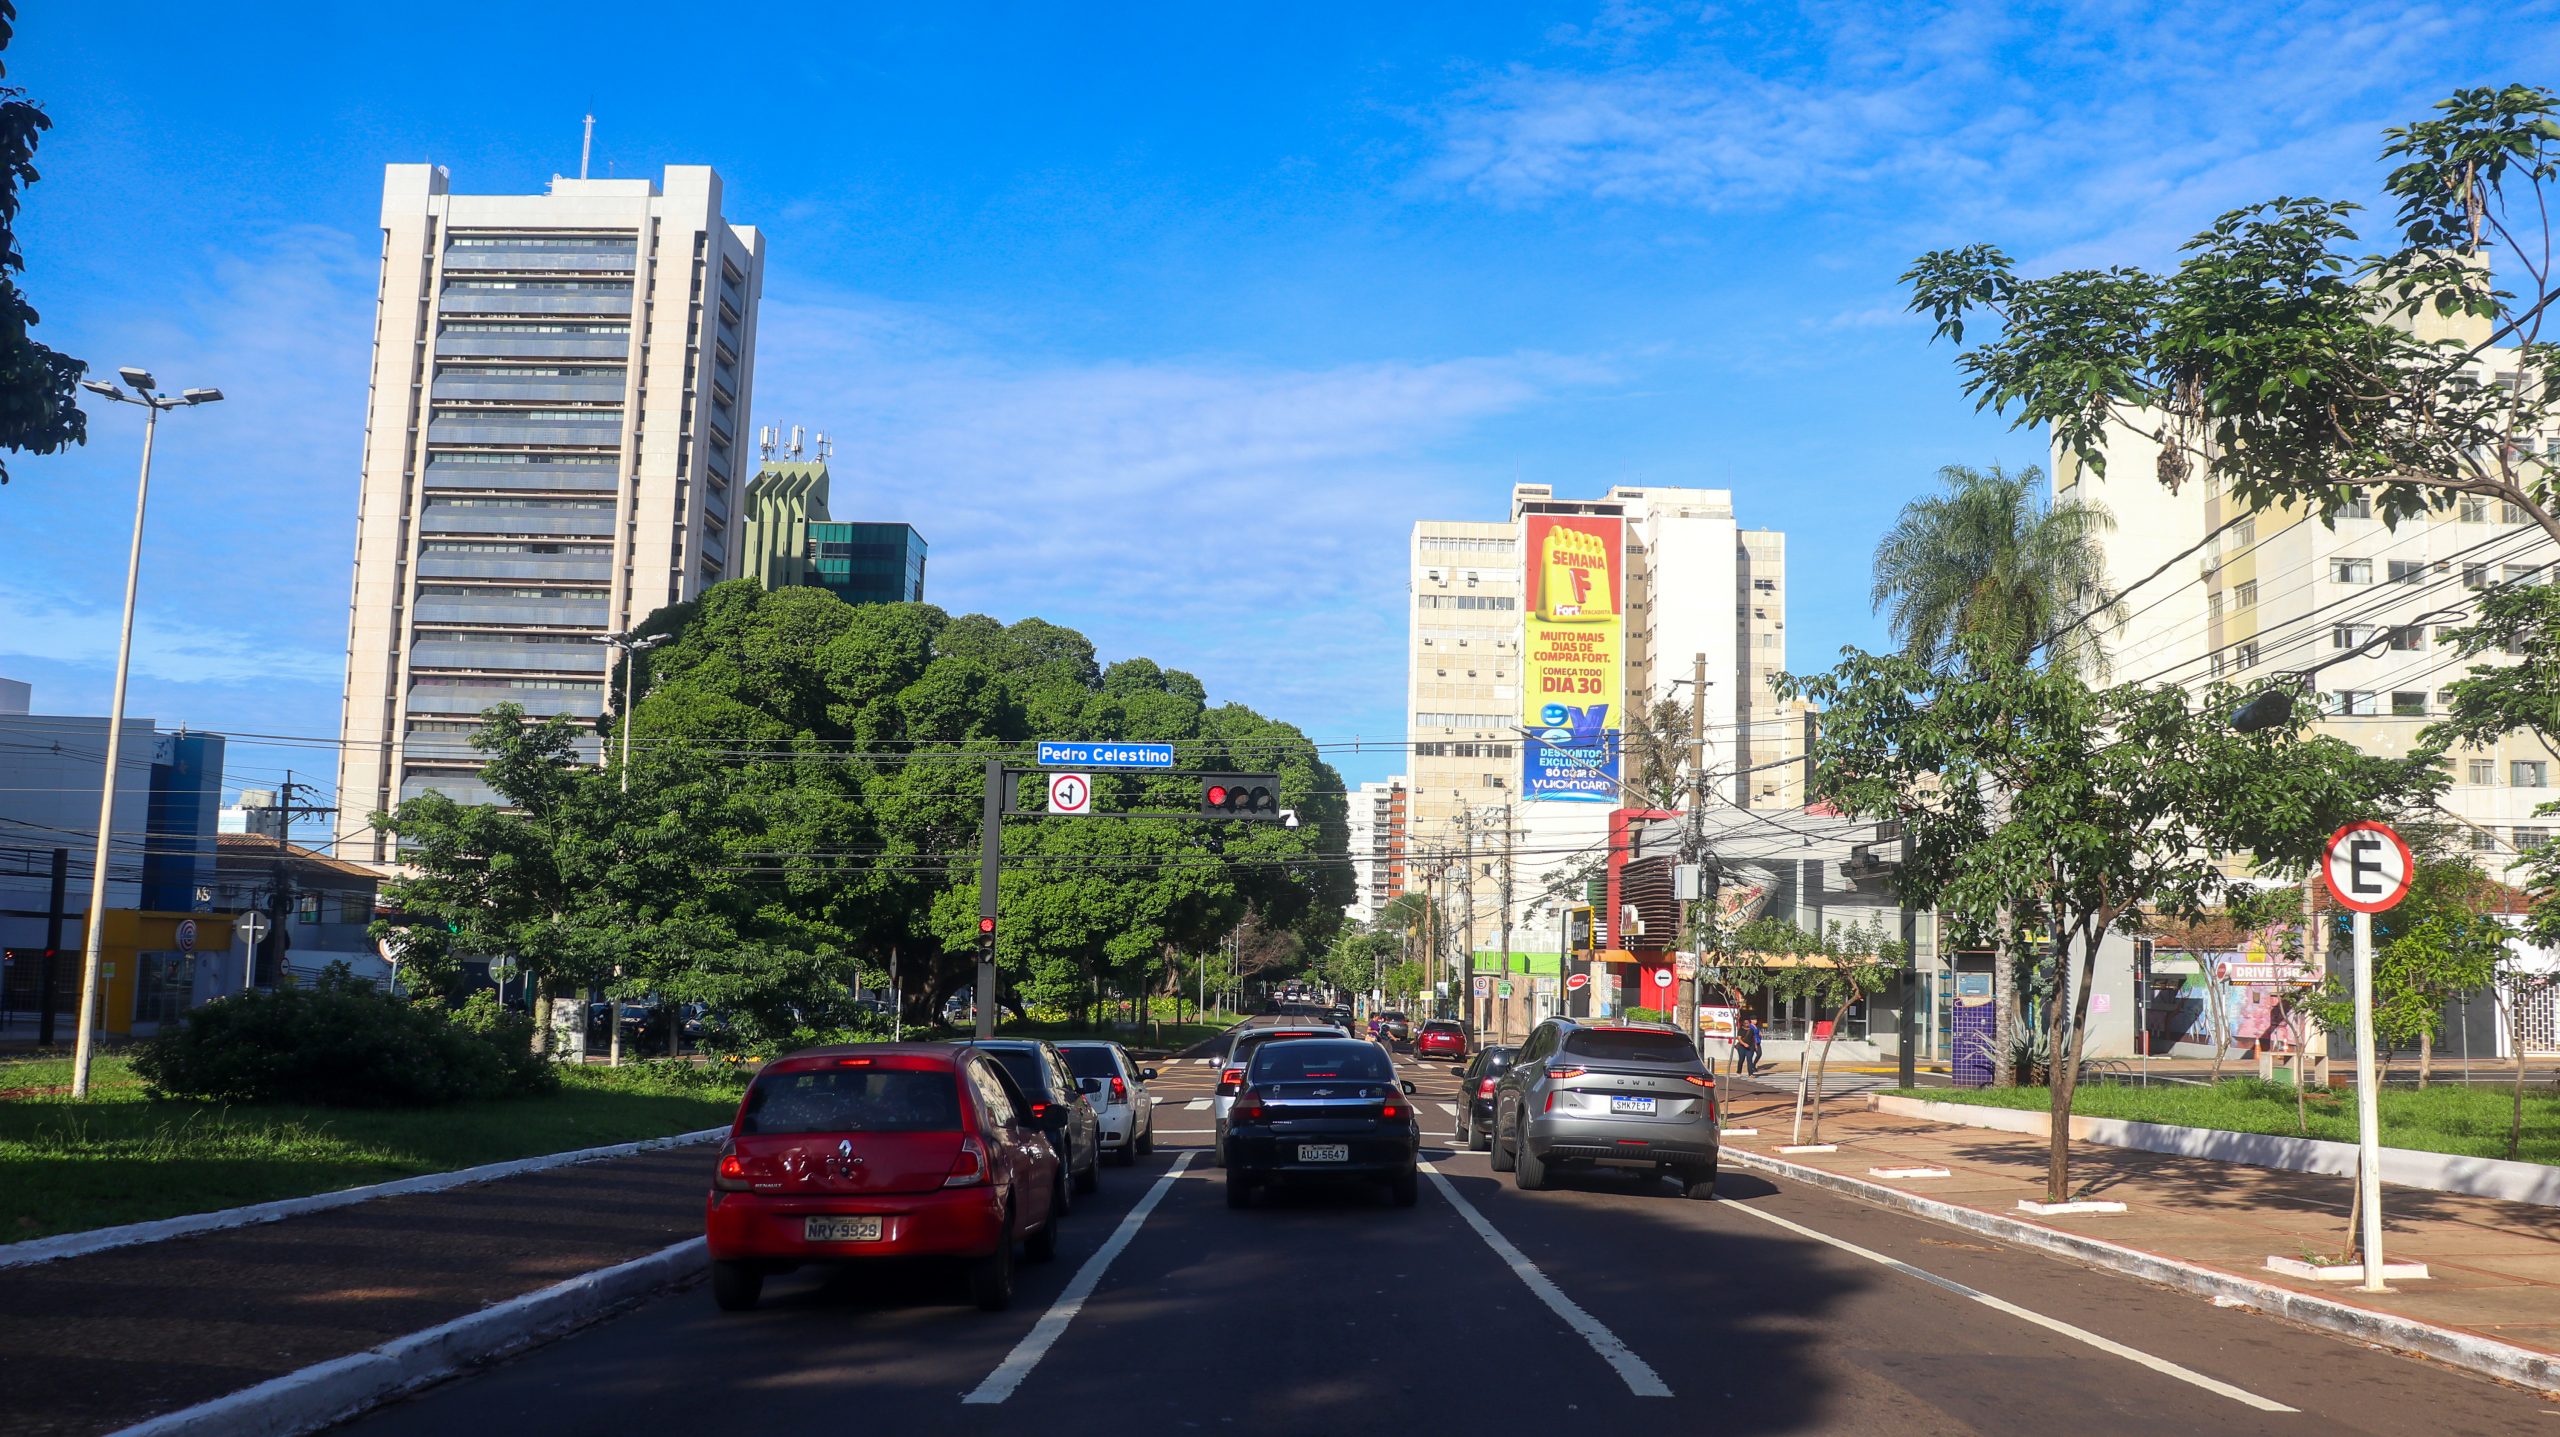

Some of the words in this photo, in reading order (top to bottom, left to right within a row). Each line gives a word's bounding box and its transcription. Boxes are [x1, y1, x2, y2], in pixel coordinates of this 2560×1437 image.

[1552, 550, 1605, 570] SEMANA
[1569, 568, 1592, 604] F
[1555, 603, 1580, 616] Fort
[1540, 631, 1576, 641] MUITO
[1577, 632, 1605, 643] MAIS
[1551, 642, 1578, 652] DIAS
[1579, 643, 1593, 652] DE
[1534, 651, 1580, 662] COMPRA
[1581, 653, 1611, 663] FORT.
[1543, 667, 1578, 678] COMEÇA
[1579, 668, 1602, 677] TODO
[1543, 677, 1575, 694] DIA
[1577, 678, 1602, 694] 30
[1041, 747, 1087, 761] Pedro
[1093, 747, 1169, 763] Celestino
[1540, 748, 1603, 758] DESCONTOS
[1539, 757, 1603, 768] EXCLUSIVOS
[1545, 766, 1560, 777] SÓ
[2350, 839, 2382, 894] E
[2236, 966, 2273, 978] DRIVE
[2275, 966, 2308, 978] THR
[1617, 1079, 1656, 1087] GWM
[1616, 1101, 1651, 1110] SMK7E17
